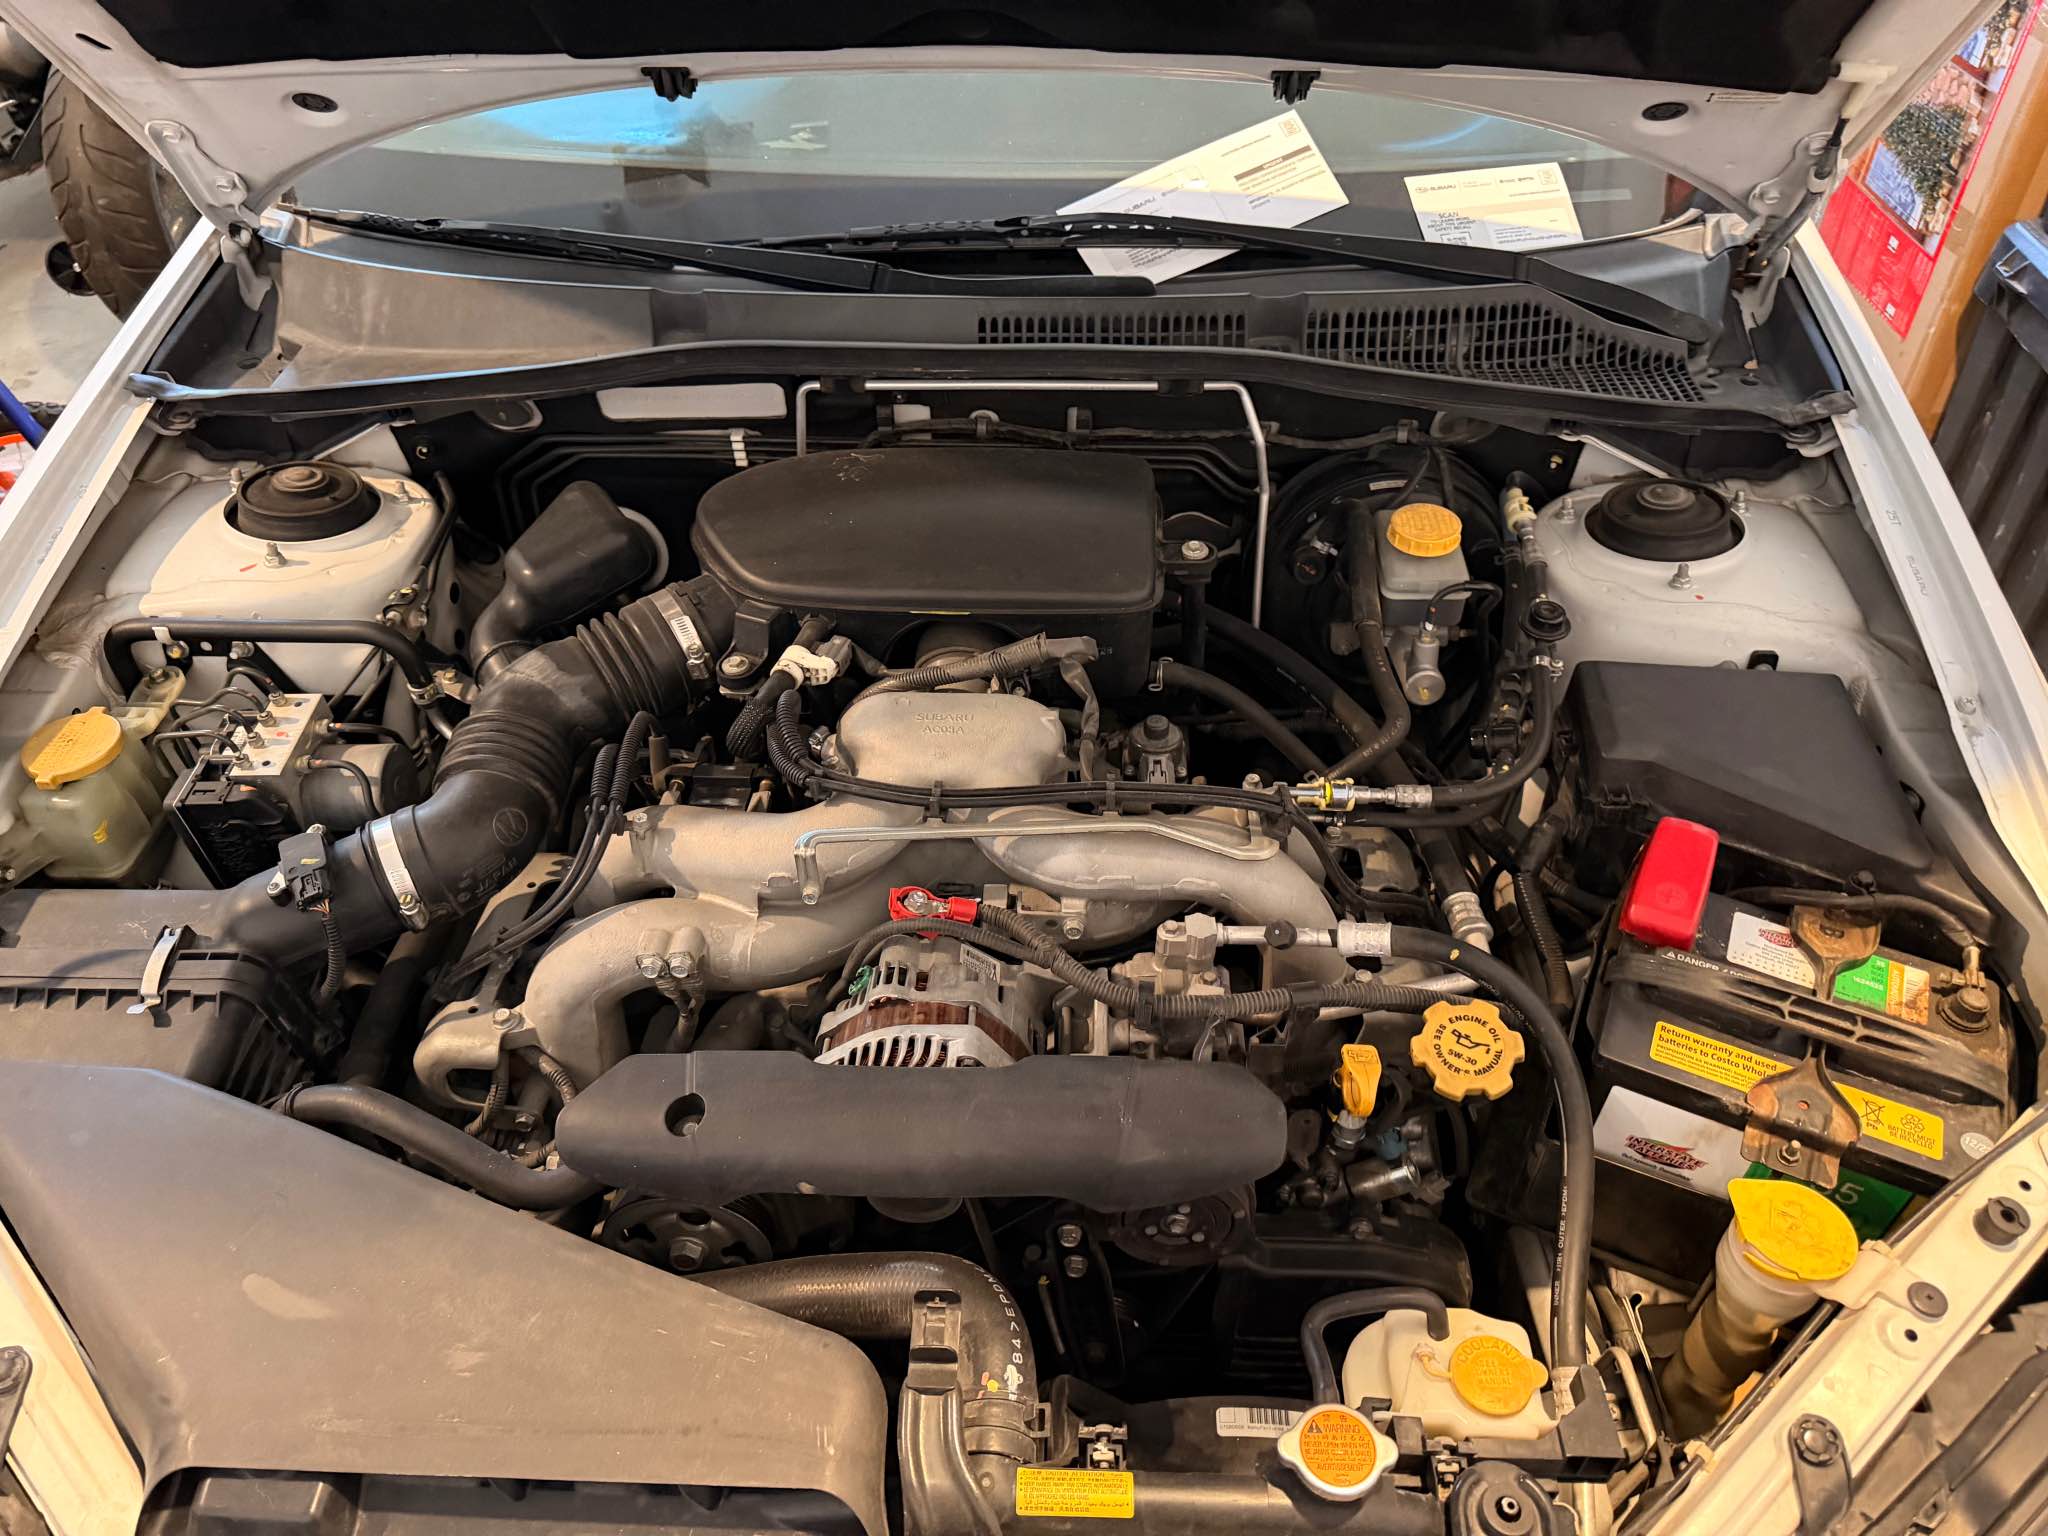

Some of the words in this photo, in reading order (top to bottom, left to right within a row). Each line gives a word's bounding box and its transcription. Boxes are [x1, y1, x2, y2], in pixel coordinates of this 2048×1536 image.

[915, 712, 975, 722] SUBARU
[1448, 1014, 1488, 1028] ENGINE
[1488, 1027, 1502, 1043] OIL
[1433, 1023, 1447, 1041] SEE
[1473, 1048, 1504, 1077] MANUAL
[1447, 1048, 1478, 1067] 5W-30
[1658, 1034, 1698, 1054] batteries
[1699, 1048, 1709, 1058] to
[1710, 1053, 1740, 1069] Costco
[1742, 1063, 1768, 1079] Whol
[1660, 1025, 1690, 1041] Return
[1692, 1038, 1733, 1056] warranty
[1735, 1051, 1753, 1063] and
[1754, 1058, 1777, 1072] used
[1627, 1134, 1705, 1168] INTERSTATE
[1627, 1142, 1698, 1171] BATTERIES
[1558, 1219, 1566, 1249] OUTER
[1456, 1336, 1521, 1364] COOLANT
[1322, 1423, 1361, 1434] WARNING
